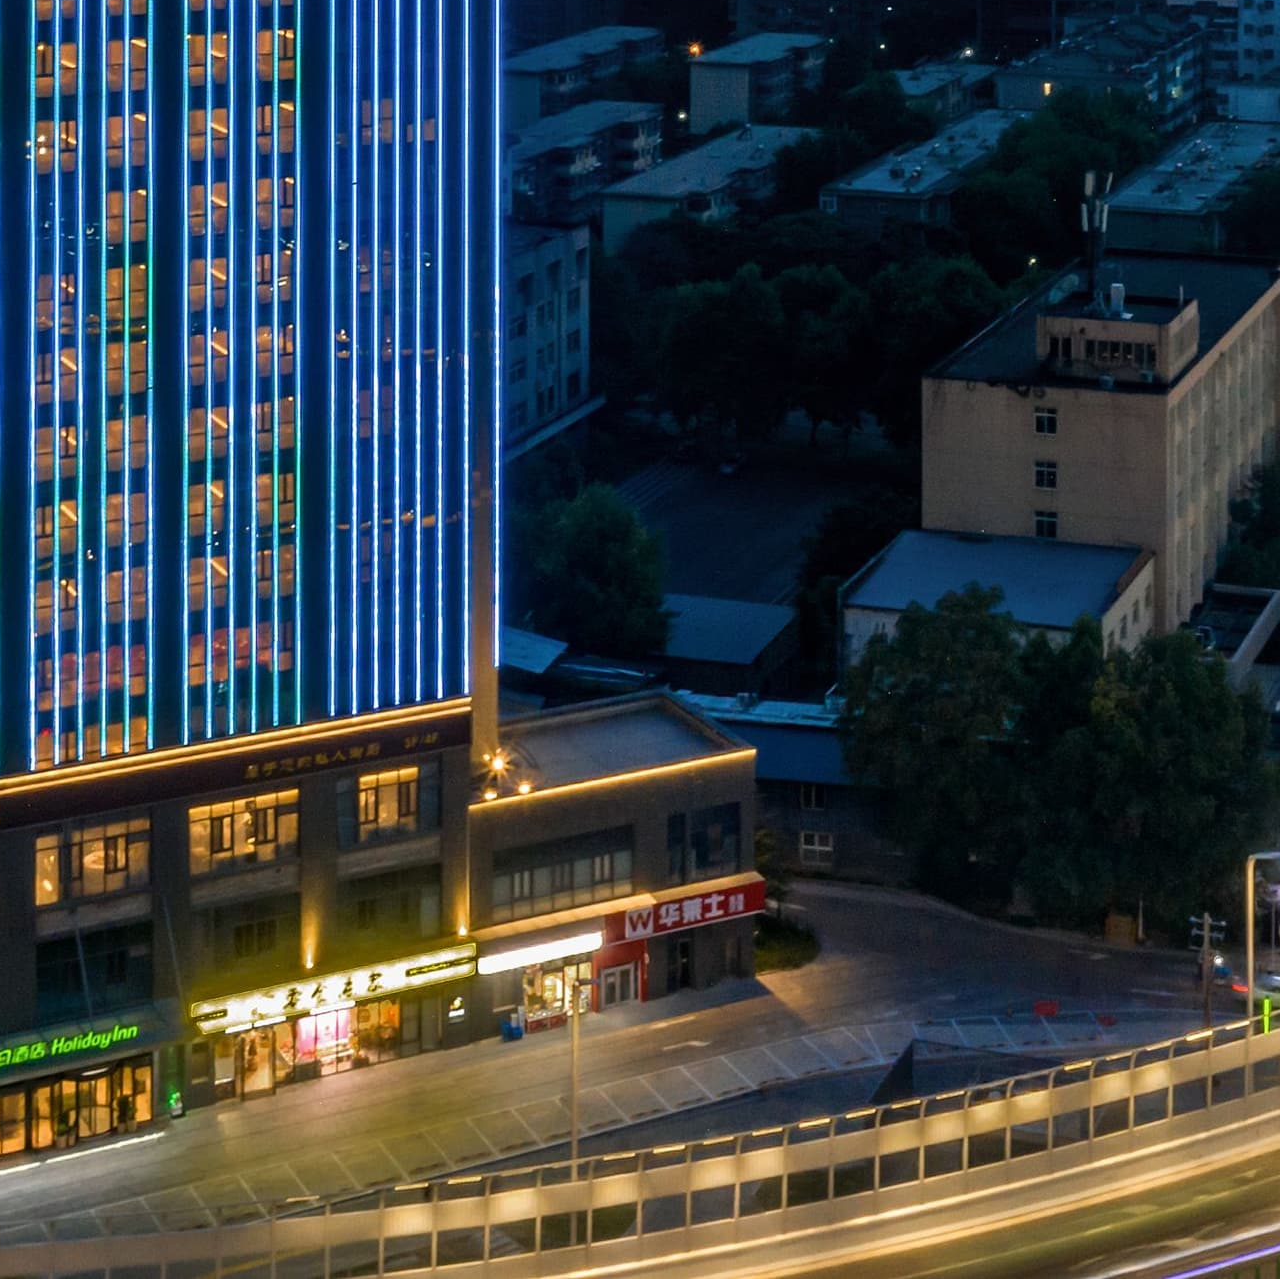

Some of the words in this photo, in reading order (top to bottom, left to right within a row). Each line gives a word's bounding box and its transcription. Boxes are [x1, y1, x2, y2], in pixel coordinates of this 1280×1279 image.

[658, 893, 725, 927] 华莱士
[51, 1031, 113, 1055] Holiday
[113, 1025, 138, 1042] Inn
